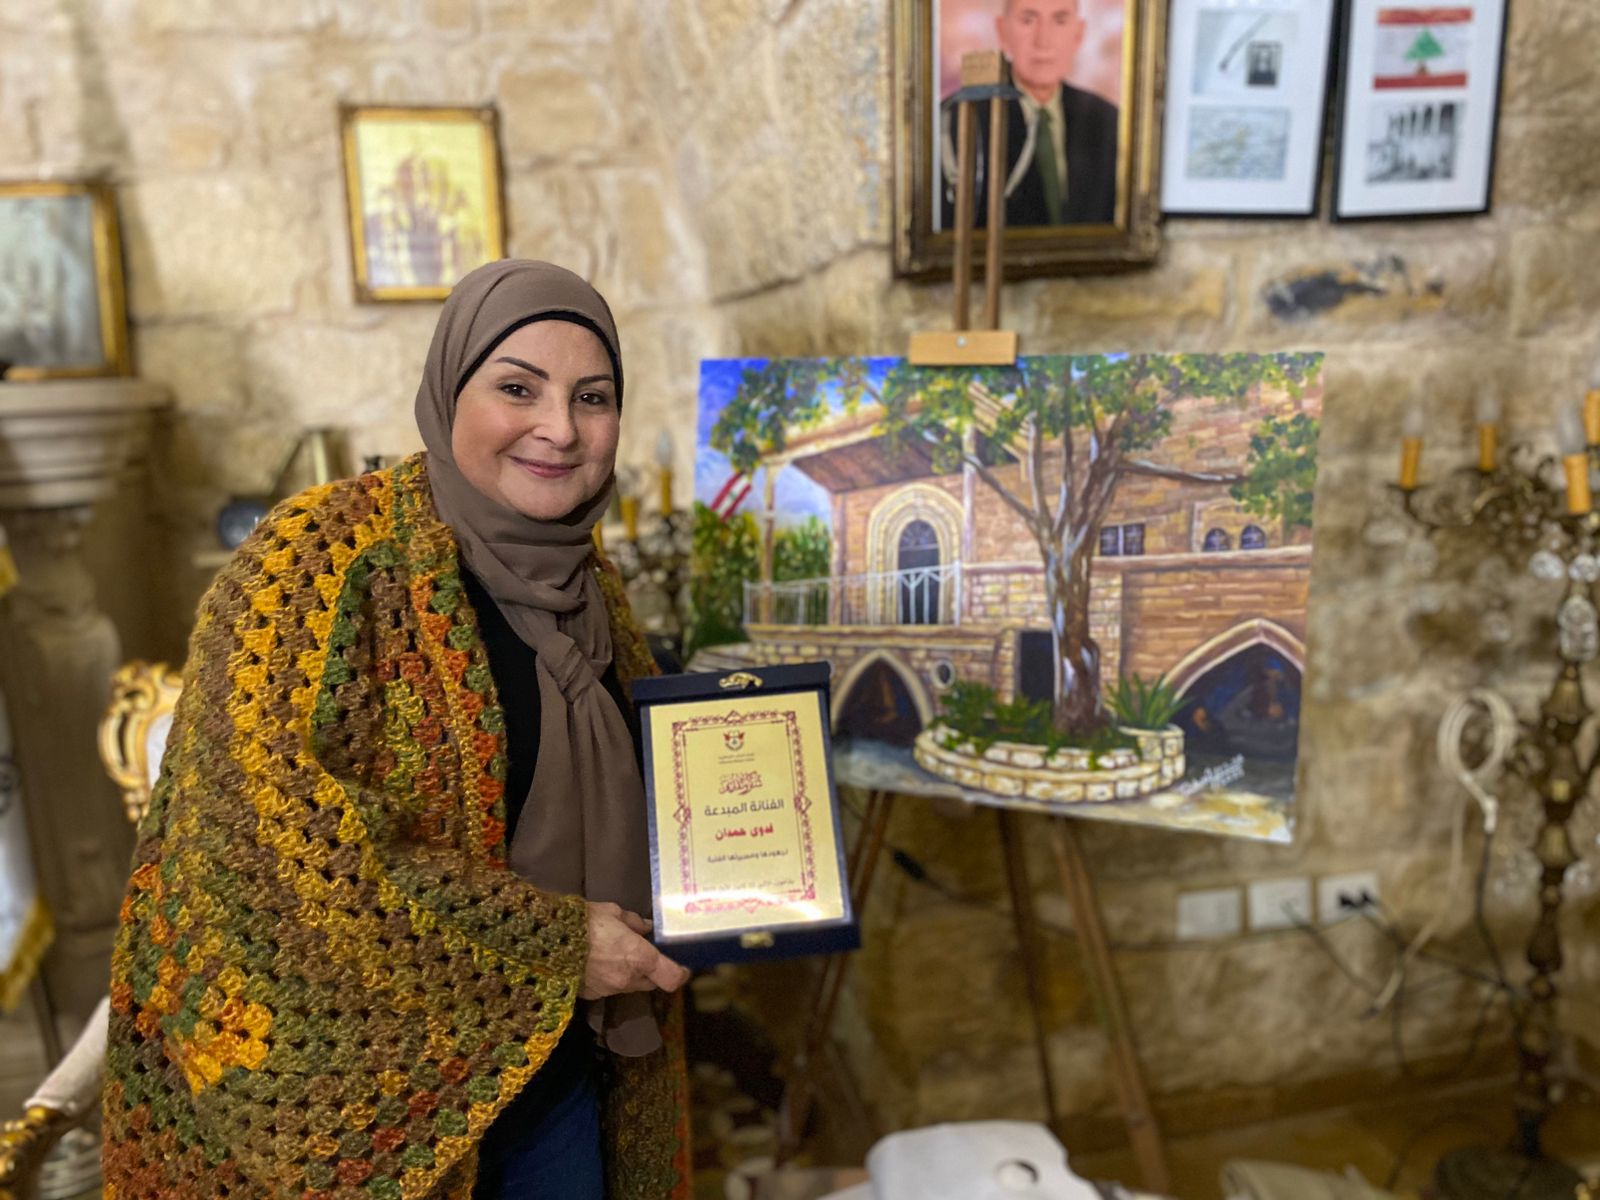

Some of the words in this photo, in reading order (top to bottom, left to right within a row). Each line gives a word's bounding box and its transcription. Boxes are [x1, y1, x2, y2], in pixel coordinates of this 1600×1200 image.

[704, 802, 747, 816] المبدعة
[750, 799, 784, 812] الفنانة
[715, 827, 746, 840] حمدان
